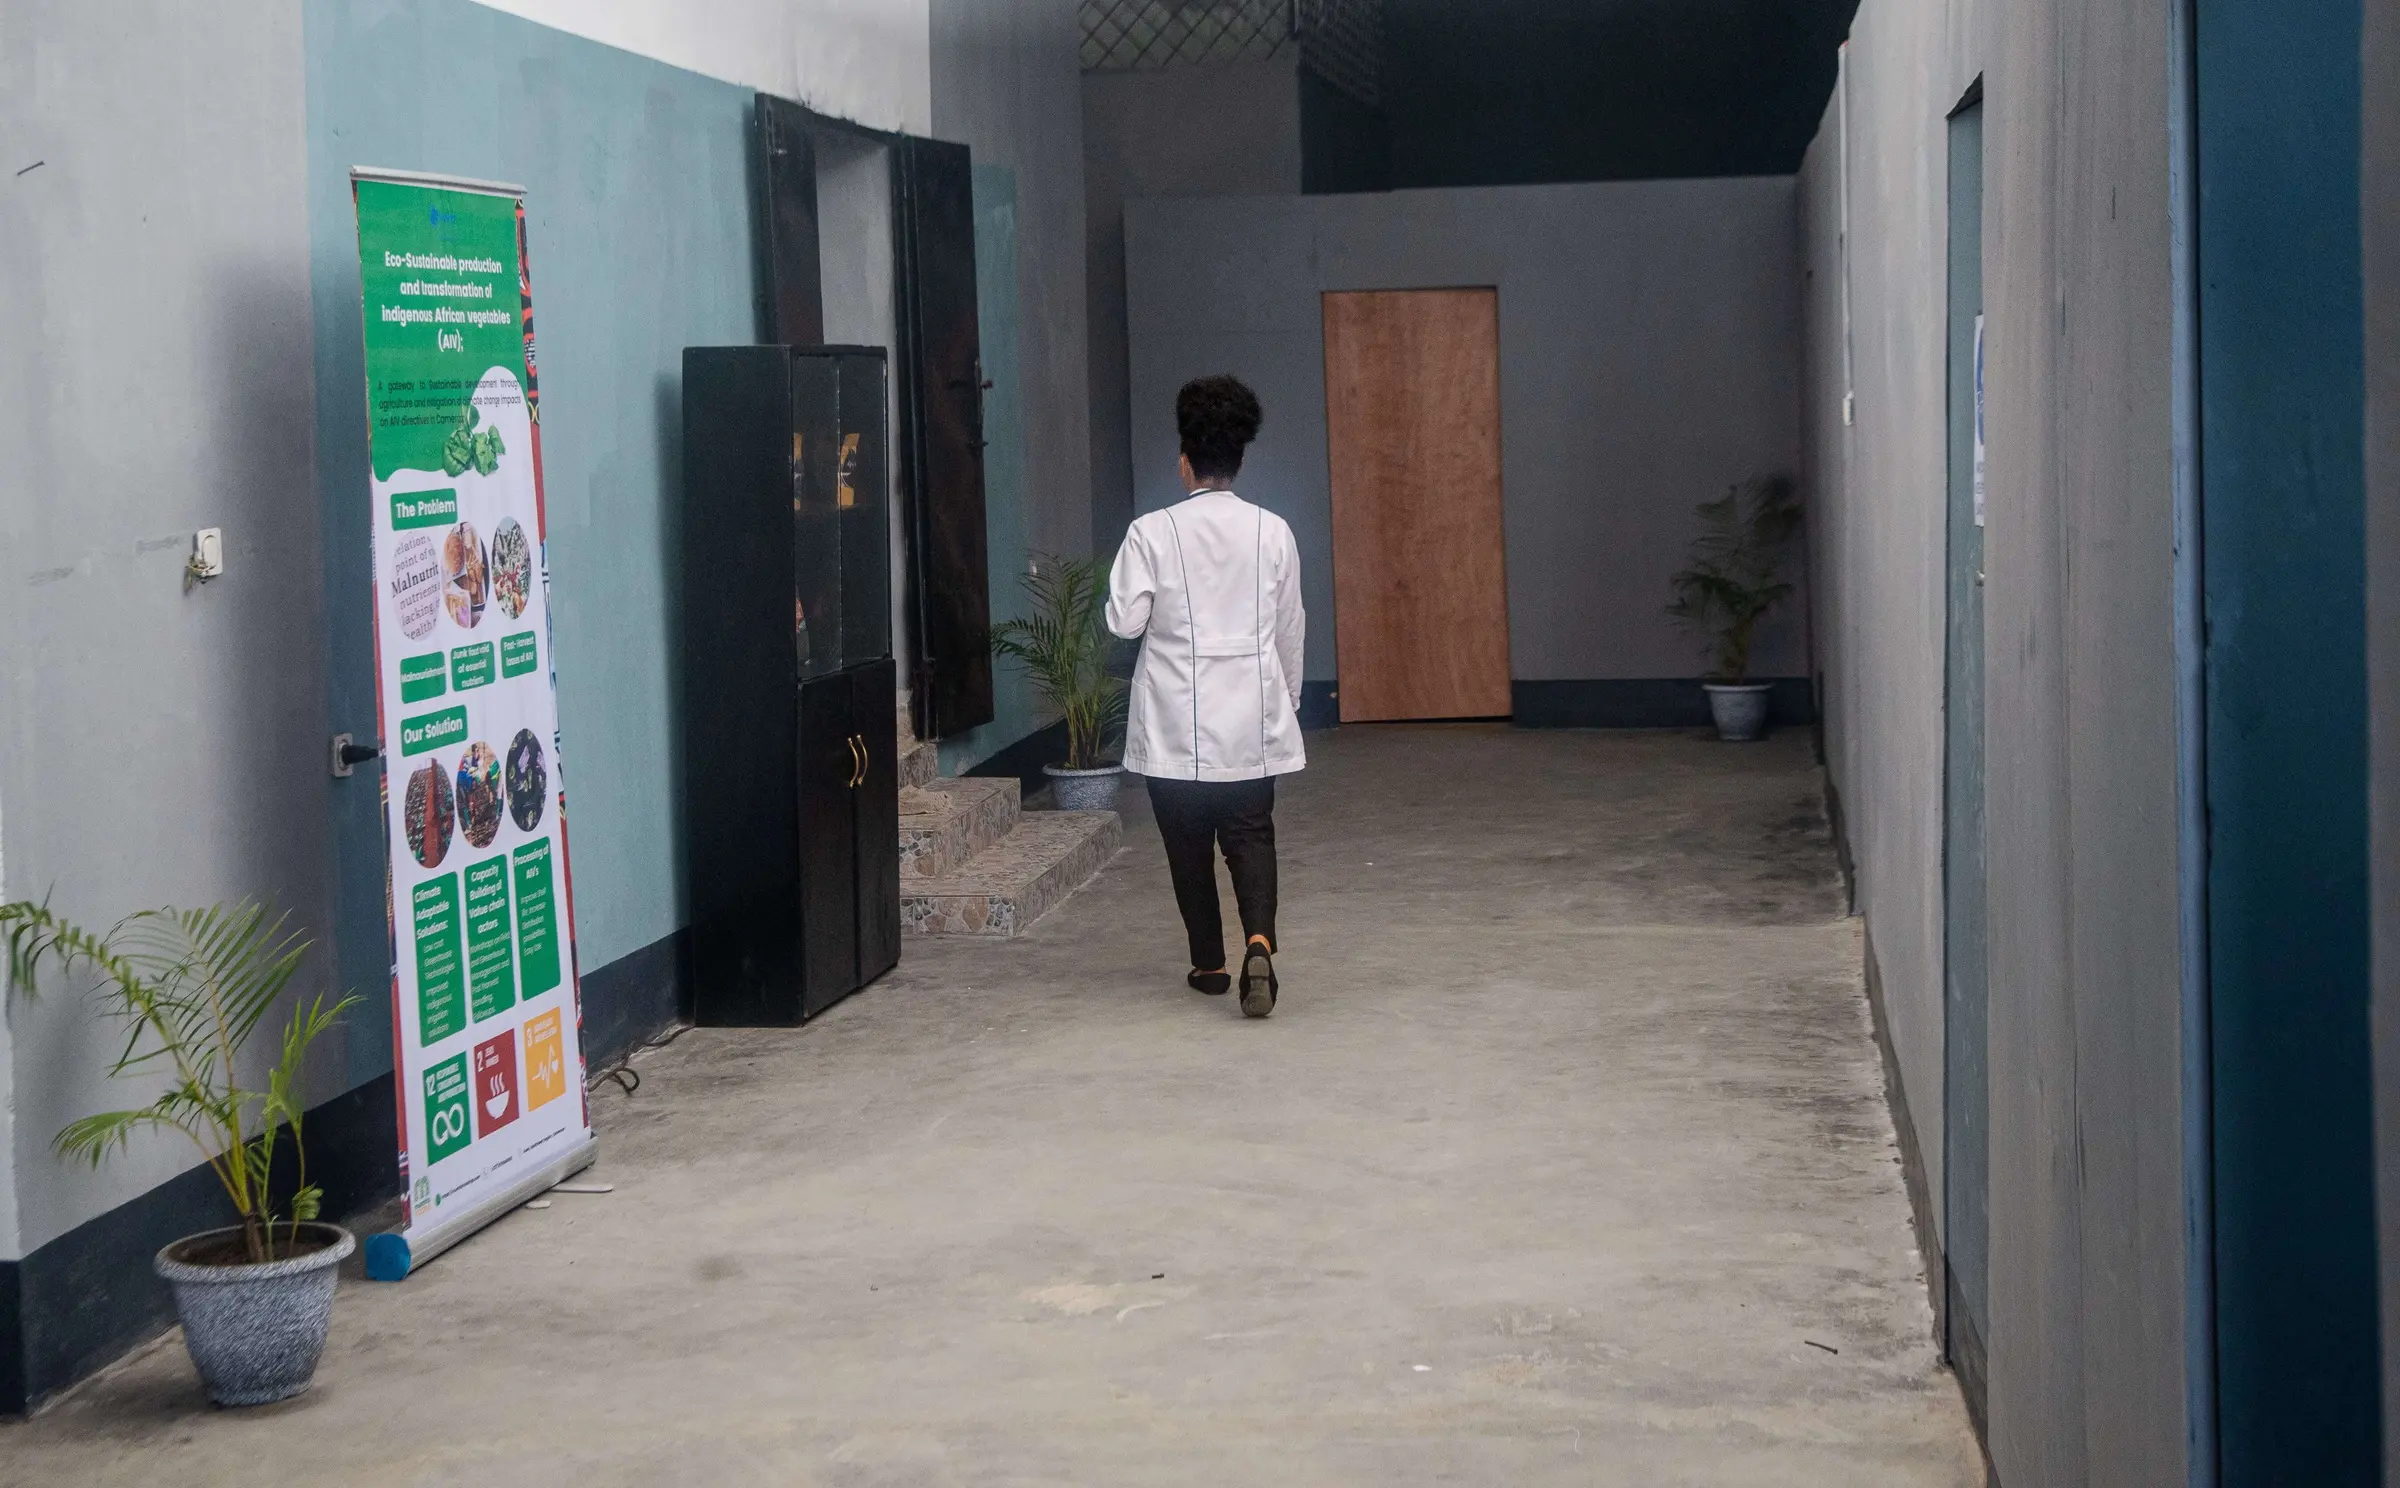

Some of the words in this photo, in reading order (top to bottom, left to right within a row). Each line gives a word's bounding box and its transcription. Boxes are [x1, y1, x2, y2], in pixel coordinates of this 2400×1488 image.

[385, 251, 457, 271] Eco-Sustainable
[459, 256, 502, 275] production
[400, 280, 420, 295] and
[421, 281, 483, 298] transformation
[485, 283, 492, 298] of
[382, 304, 433, 327] indigenous
[435, 308, 465, 323] African
[467, 311, 510, 328] vegetables
[388, 381, 415, 394] gateway
[420, 380, 426, 390] to
[465, 379, 498, 390] development
[379, 397, 412, 412] agriculture
[414, 396, 426, 408] and
[426, 395, 455, 409] mitigation
[462, 395, 482, 406] climate
[484, 395, 500, 407] change
[501, 394, 521, 407] impacts
[380, 418, 389, 427] on
[390, 415, 400, 426] AIV
[401, 415, 429, 426] directives
[396, 503, 416, 518] The
[418, 498, 455, 516] Problem
[395, 554, 418, 576] point
[420, 548, 427, 560] of
[453, 647, 468, 660] Junk
[404, 728, 423, 744] Our
[425, 716, 463, 739] Solution
[514, 847, 544, 867] Processing
[471, 863, 500, 883] Capacity
[415, 885, 441, 903] Climate
[469, 883, 497, 901] Building
[416, 901, 450, 921] Adaptable
[469, 903, 488, 919] Value
[488, 897, 506, 914] chain
[477, 919, 498, 934] actors
[526, 1027, 533, 1048] 3
[476, 1050, 484, 1073] 2
[427, 1073, 436, 1097] 12
